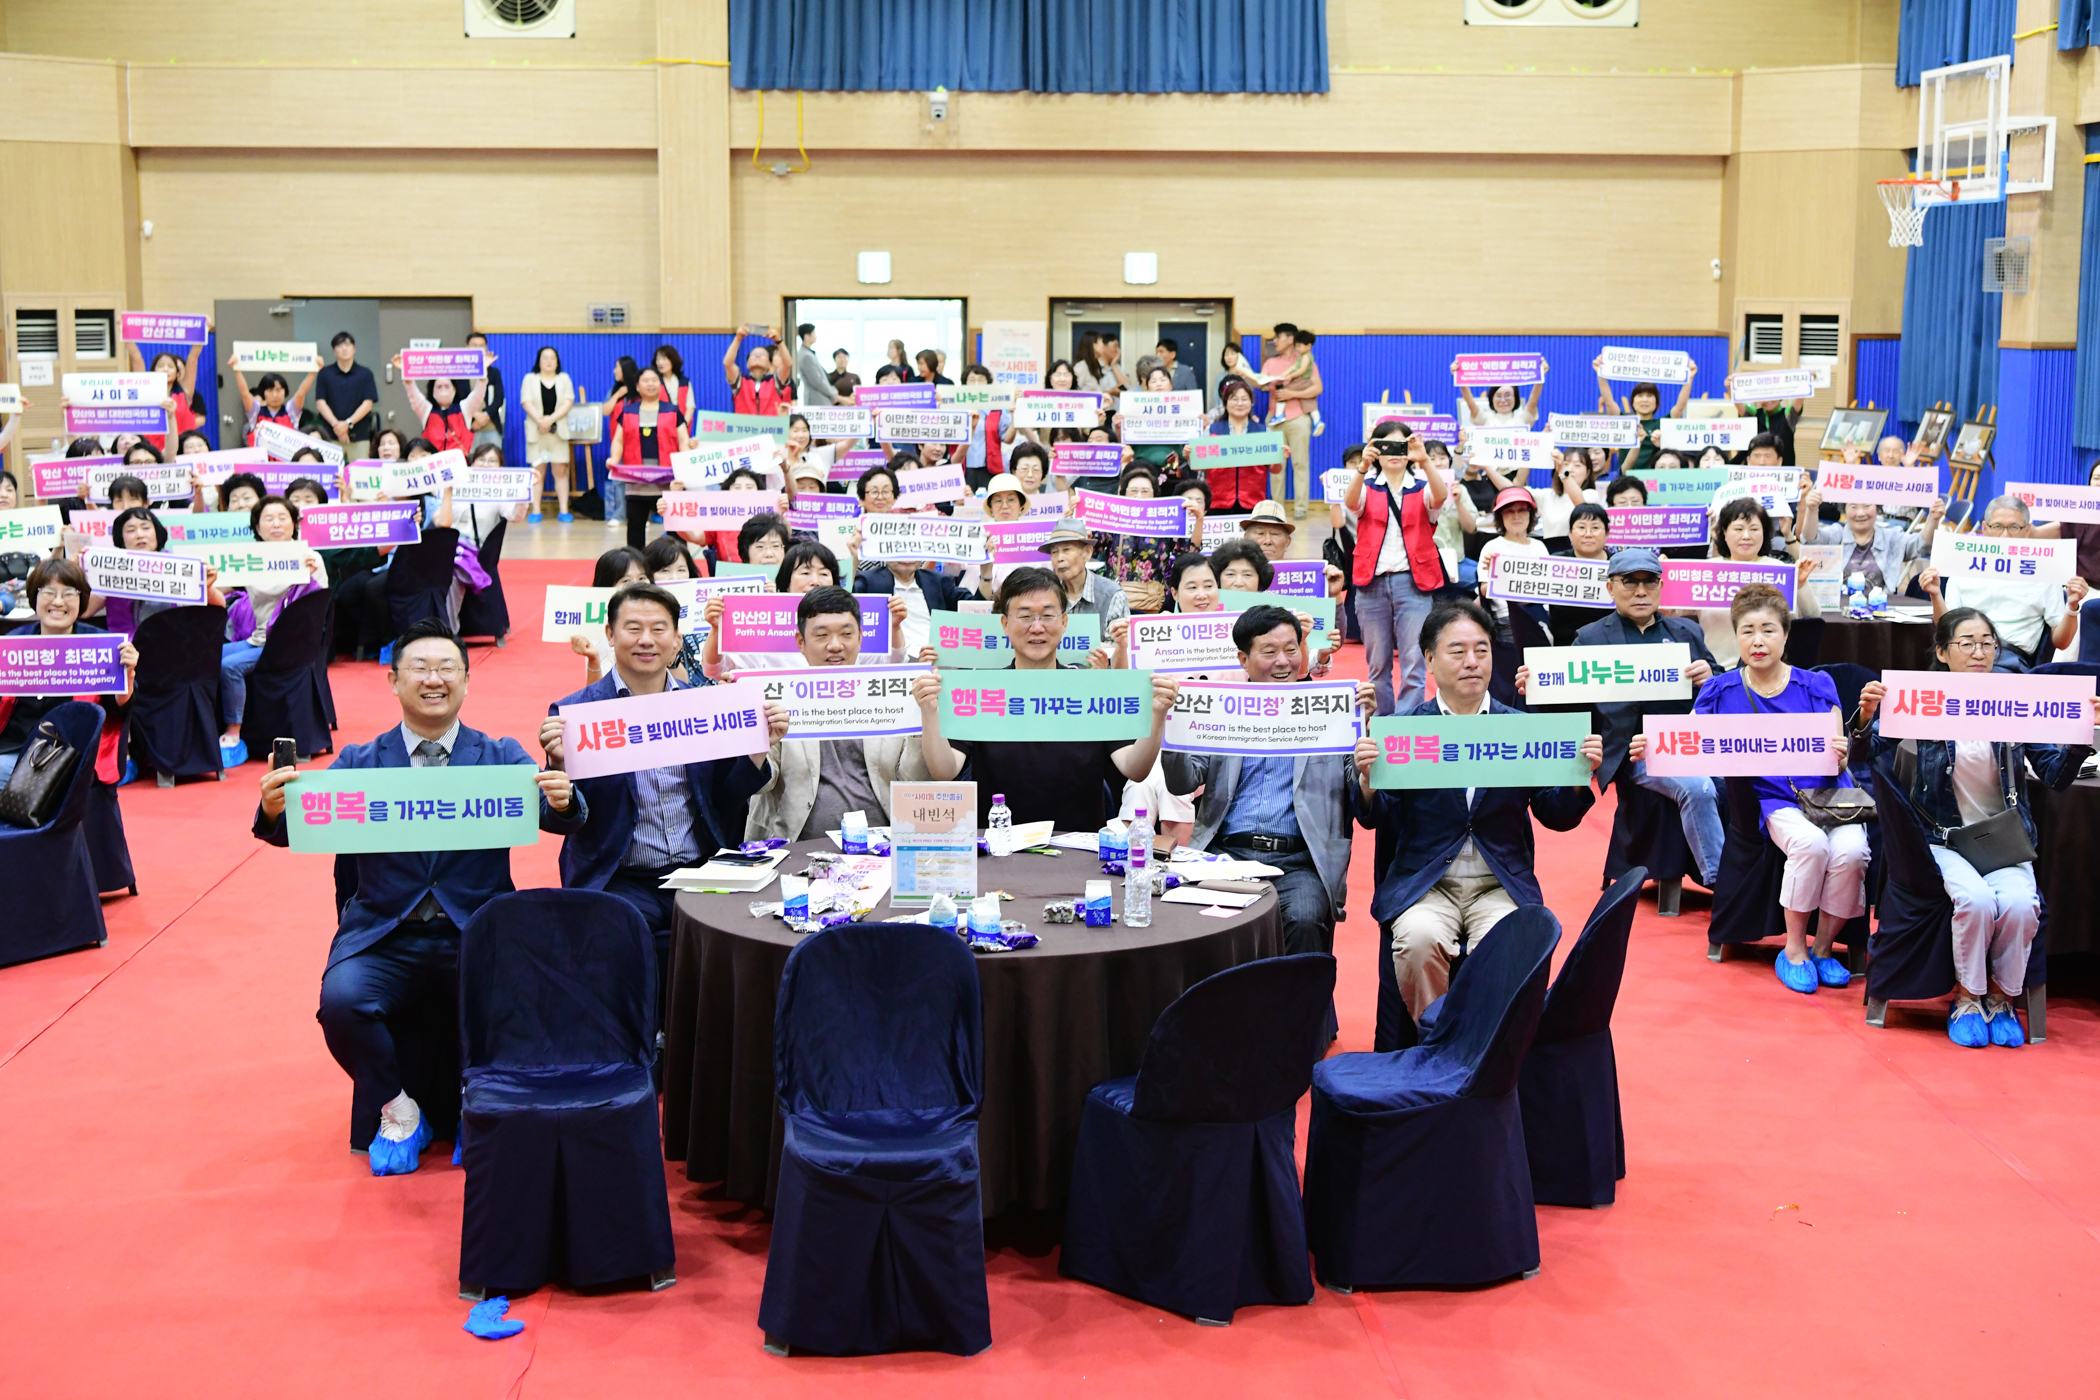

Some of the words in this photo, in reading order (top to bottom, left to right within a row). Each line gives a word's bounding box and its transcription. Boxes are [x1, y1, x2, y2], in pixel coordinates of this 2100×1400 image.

[142, 328, 186, 339] 안산으로
[256, 350, 290, 363] 나누는
[1608, 353, 1640, 363] 이민청!
[1642, 354, 1670, 365] 안산의
[1674, 356, 1682, 366] 길
[1007, 361, 1038, 372] 사이동
[1612, 366, 1660, 378] 대한민국의
[996, 373, 1037, 384] 주민총회
[956, 392, 989, 403] 나누는
[828, 411, 855, 421] 안산의
[857, 411, 865, 420] 길
[885, 414, 916, 425] 이민청!
[920, 415, 950, 425] 안산의
[953, 415, 962, 425] 길
[702, 420, 734, 433] 행복을
[736, 424, 759, 434] 가꾸는
[760, 426, 783, 435] 사이동
[849, 424, 861, 432] 길!
[1555, 420, 1587, 429] 이민청!
[1590, 421, 1619, 430] 안산의
[1621, 421, 1631, 430] 길
[891, 428, 940, 439] 대한민국의
[944, 428, 956, 439] 길!
[1560, 431, 1610, 442] 대한민국의
[1613, 433, 1626, 442] 길!
[1484, 437, 1512, 446] 우리사이,
[1514, 437, 1540, 446] 좋은사이
[1195, 444, 1228, 459] 행복을
[1230, 446, 1253, 456] 가꾸는
[1255, 444, 1278, 454] 사이동
[42, 467, 61, 479] 안산
[175, 469, 185, 478] 길
[482, 474, 512, 484] 안산의
[515, 474, 524, 483] 길
[166, 483, 180, 493] 길!
[908, 482, 938, 492] 빚어내는
[940, 478, 961, 489] 사이동
[1670, 482, 1694, 491] 가꾸는
[1696, 482, 1721, 491] 사이동
[1823, 473, 1863, 490] 사랑을
[1866, 480, 1903, 492] 빚어내는
[1905, 482, 1934, 493] 사이동
[452, 487, 502, 498] 대한민국의
[505, 487, 518, 497] 길!
[670, 502, 708, 517] 사랑을
[710, 505, 746, 517] 빚어내는
[826, 502, 855, 513] 최적지
[1040, 505, 1063, 515] 사이동
[1084, 498, 1104, 510] 안산
[1147, 505, 1179, 518] 최적지
[2045, 499, 2077, 510] 빚어내는
[307, 512, 348, 524] 이민청은
[351, 510, 411, 522] 상호문화도시
[1669, 513, 1701, 524] 최적지
[27, 524, 55, 536] 사이동
[198, 528, 229, 539] 가꾸는
[329, 523, 390, 541] 안산으로
[870, 522, 916, 536] 이민청!
[920, 523, 962, 537] 안산의
[967, 523, 981, 536] 길
[1002, 534, 1015, 545] 길!
[879, 541, 950, 555] 대한민국의
[955, 542, 972, 557] 길!
[1954, 541, 2004, 555] 우리사이,
[2008, 545, 2054, 558] 좋은사이
[91, 555, 133, 571] 이민청!
[138, 559, 177, 576] 안산의
[181, 563, 194, 577] 길
[209, 554, 264, 573] 나누는
[267, 559, 300, 572] 사이동
[1503, 560, 1548, 578] 이민청!
[1552, 565, 1594, 580] 안산의
[1278, 571, 1316, 584] 최적지
[1668, 570, 1713, 582] 이민청은
[1717, 571, 1786, 586] 상호문화도시
[99, 574, 165, 592] 대한민국의
[169, 580, 186, 595] 길!
[1508, 580, 1579, 599] 대한민국의
[1583, 584, 1600, 600] 길!
[554, 610, 581, 625] 함께
[732, 611, 771, 626] 안산의
[775, 611, 792, 625] 길!
[863, 612, 879, 626] 길!
[939, 625, 998, 650] 행복을
[1140, 625, 1172, 642] 안산
[65, 648, 113, 665] 최적지
[1154, 648, 1184, 656] Ansan
[1206, 646, 1221, 654] best
[23, 669, 42, 677] best
[44, 669, 67, 678] place
[79, 668, 98, 676] host
[1538, 672, 1565, 686] 함께
[1568, 660, 1635, 685] 나누는
[1638, 668, 1679, 683] 사이동
[51, 677, 83, 685] Service
[85, 676, 116, 686] Agency
[951, 688, 1024, 717] 행복을
[1030, 698, 1082, 715] 가꾸는
[1087, 697, 1140, 715] 사이동
[1173, 694, 1213, 714] 안산
[1291, 694, 1350, 715] 최적지
[1893, 690, 1961, 717] 사랑을
[1965, 700, 2029, 718] 빚어내는
[2032, 700, 2082, 719] 사이동
[811, 708, 825, 716] the
[827, 707, 846, 716] best
[848, 707, 872, 718] place
[885, 706, 904, 714] host
[802, 719, 842, 727] Immigration
[870, 717, 896, 726] Agency
[1189, 721, 1226, 732] Ansan
[1237, 724, 1251, 733] the
[1253, 725, 1271, 733] best
[1272, 725, 1295, 735] place
[1308, 723, 1327, 731] host
[577, 718, 643, 752] 사랑을
[647, 716, 708, 742] 빚어내는
[712, 709, 758, 732] 사이동
[1228, 734, 1266, 743] Immigration
[1268, 735, 1292, 743] Service
[1294, 734, 1318, 743] Agency
[1655, 731, 1716, 756] 사랑을
[1719, 738, 1777, 753] 빚어내는
[1781, 738, 1826, 753] 사이동
[1384, 735, 1459, 765] 행복을
[1464, 743, 1517, 760] 가꾸는
[1522, 741, 1576, 759] 사이동
[301, 791, 388, 825] 행복을
[395, 799, 456, 820] 가꾸는
[462, 797, 524, 819] 사이동
[913, 807, 955, 822] 내빈석
